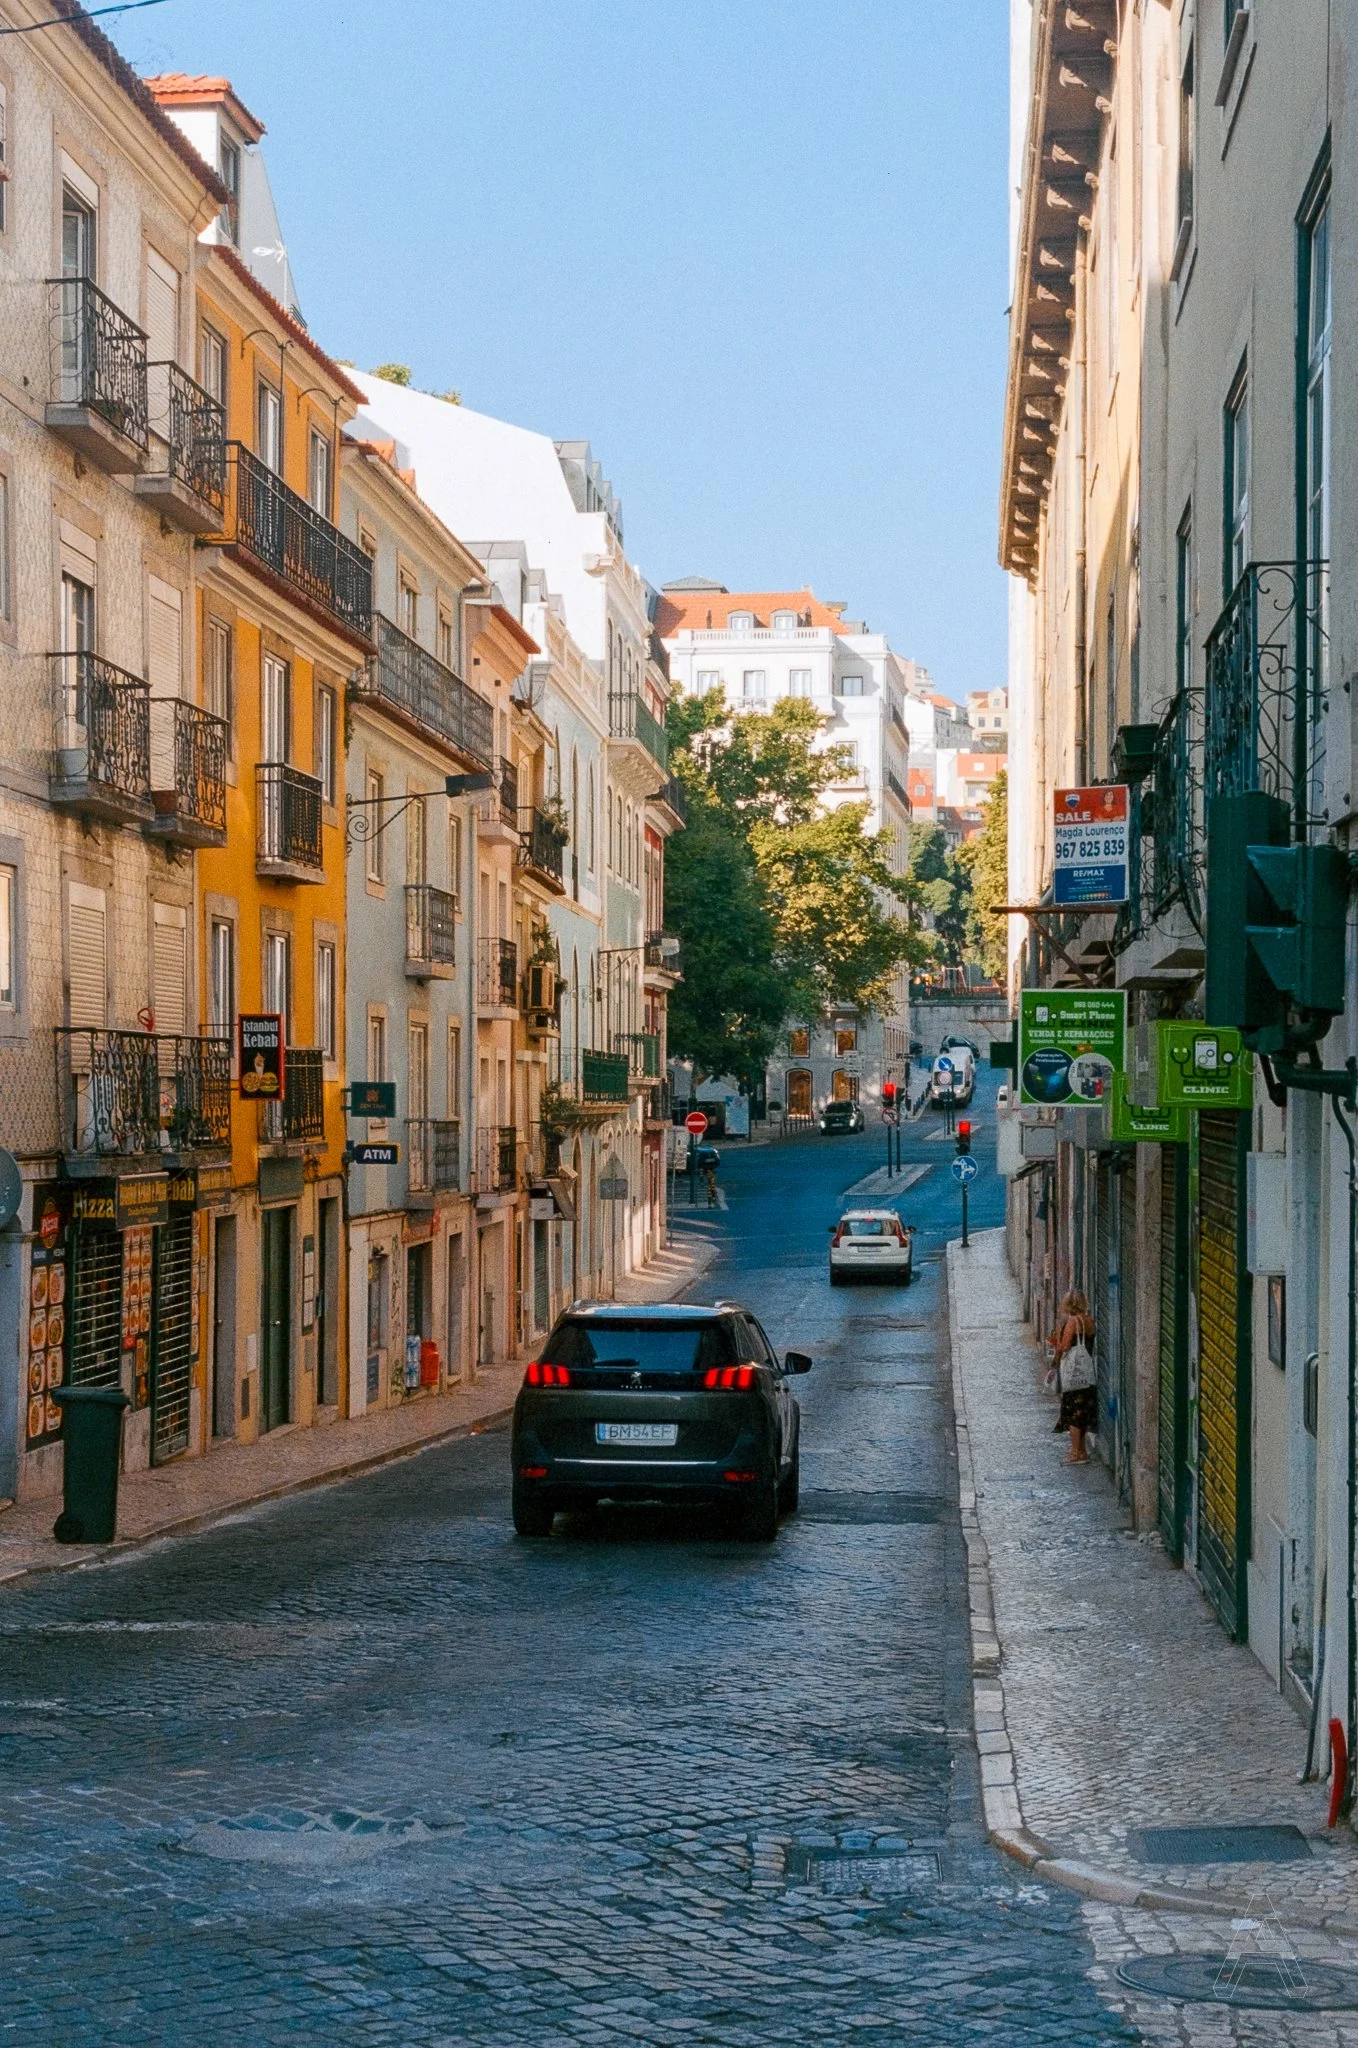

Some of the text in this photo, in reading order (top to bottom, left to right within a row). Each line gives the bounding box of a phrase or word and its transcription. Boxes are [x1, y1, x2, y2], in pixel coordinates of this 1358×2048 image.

[1055, 811, 1091, 823] SALE
[1056, 826, 1124, 840] Magda Lourenço
[1055, 839, 1125, 859] 967 825 839
[1073, 868, 1105, 878] RE/MAX
[1060, 1010, 1115, 1019] Smart Phone
[243, 1021, 278, 1031] Istanbul
[1028, 1029, 1115, 1039] VENDA E REPARAÇÕES
[243, 1033, 278, 1047] Kebab
[363, 1149, 391, 1160] ATM
[72, 1191, 115, 1218] Pizza
